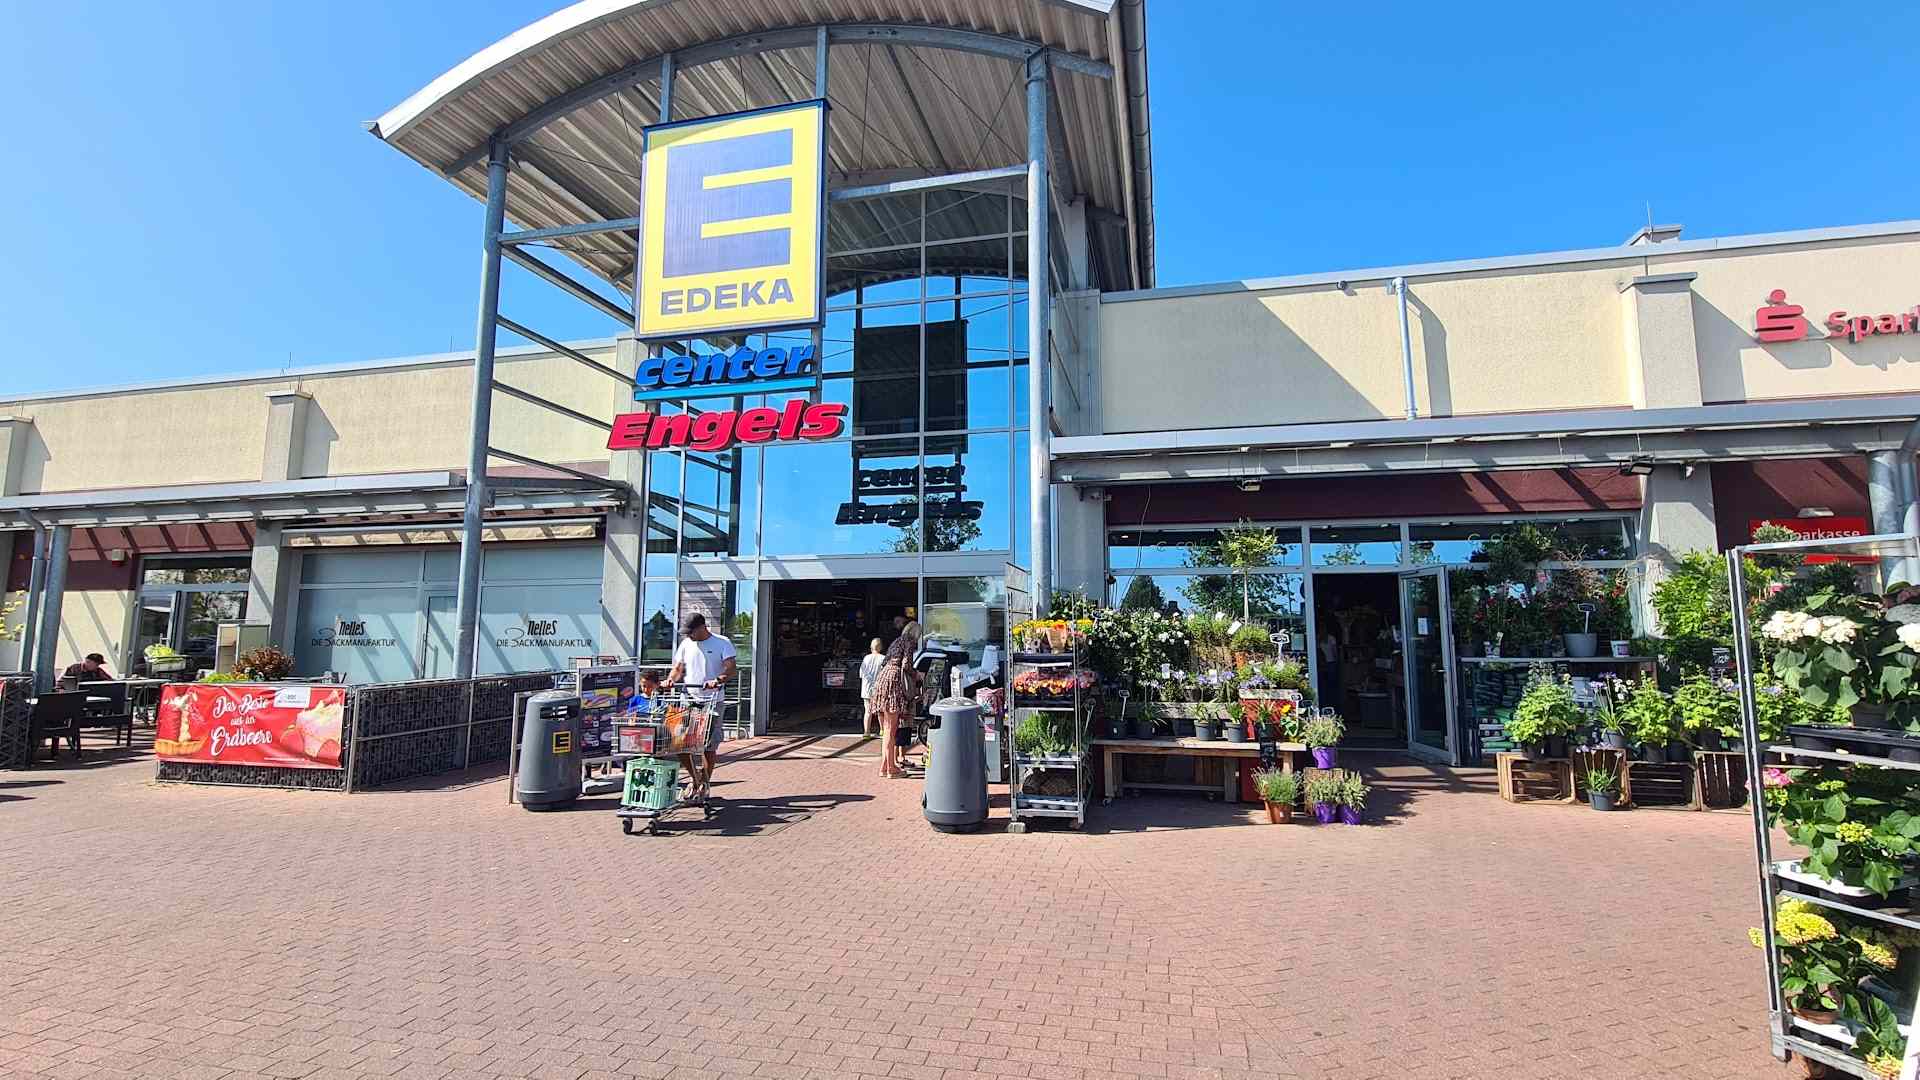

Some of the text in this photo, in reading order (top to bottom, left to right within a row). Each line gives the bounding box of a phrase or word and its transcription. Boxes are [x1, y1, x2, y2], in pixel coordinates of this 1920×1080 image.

[663, 128, 793, 278] E
[661, 278, 794, 315] EDEKA
[636, 344, 816, 387] center
[607, 400, 848, 452] Engels
[211, 726, 273, 756] Erdbeere
